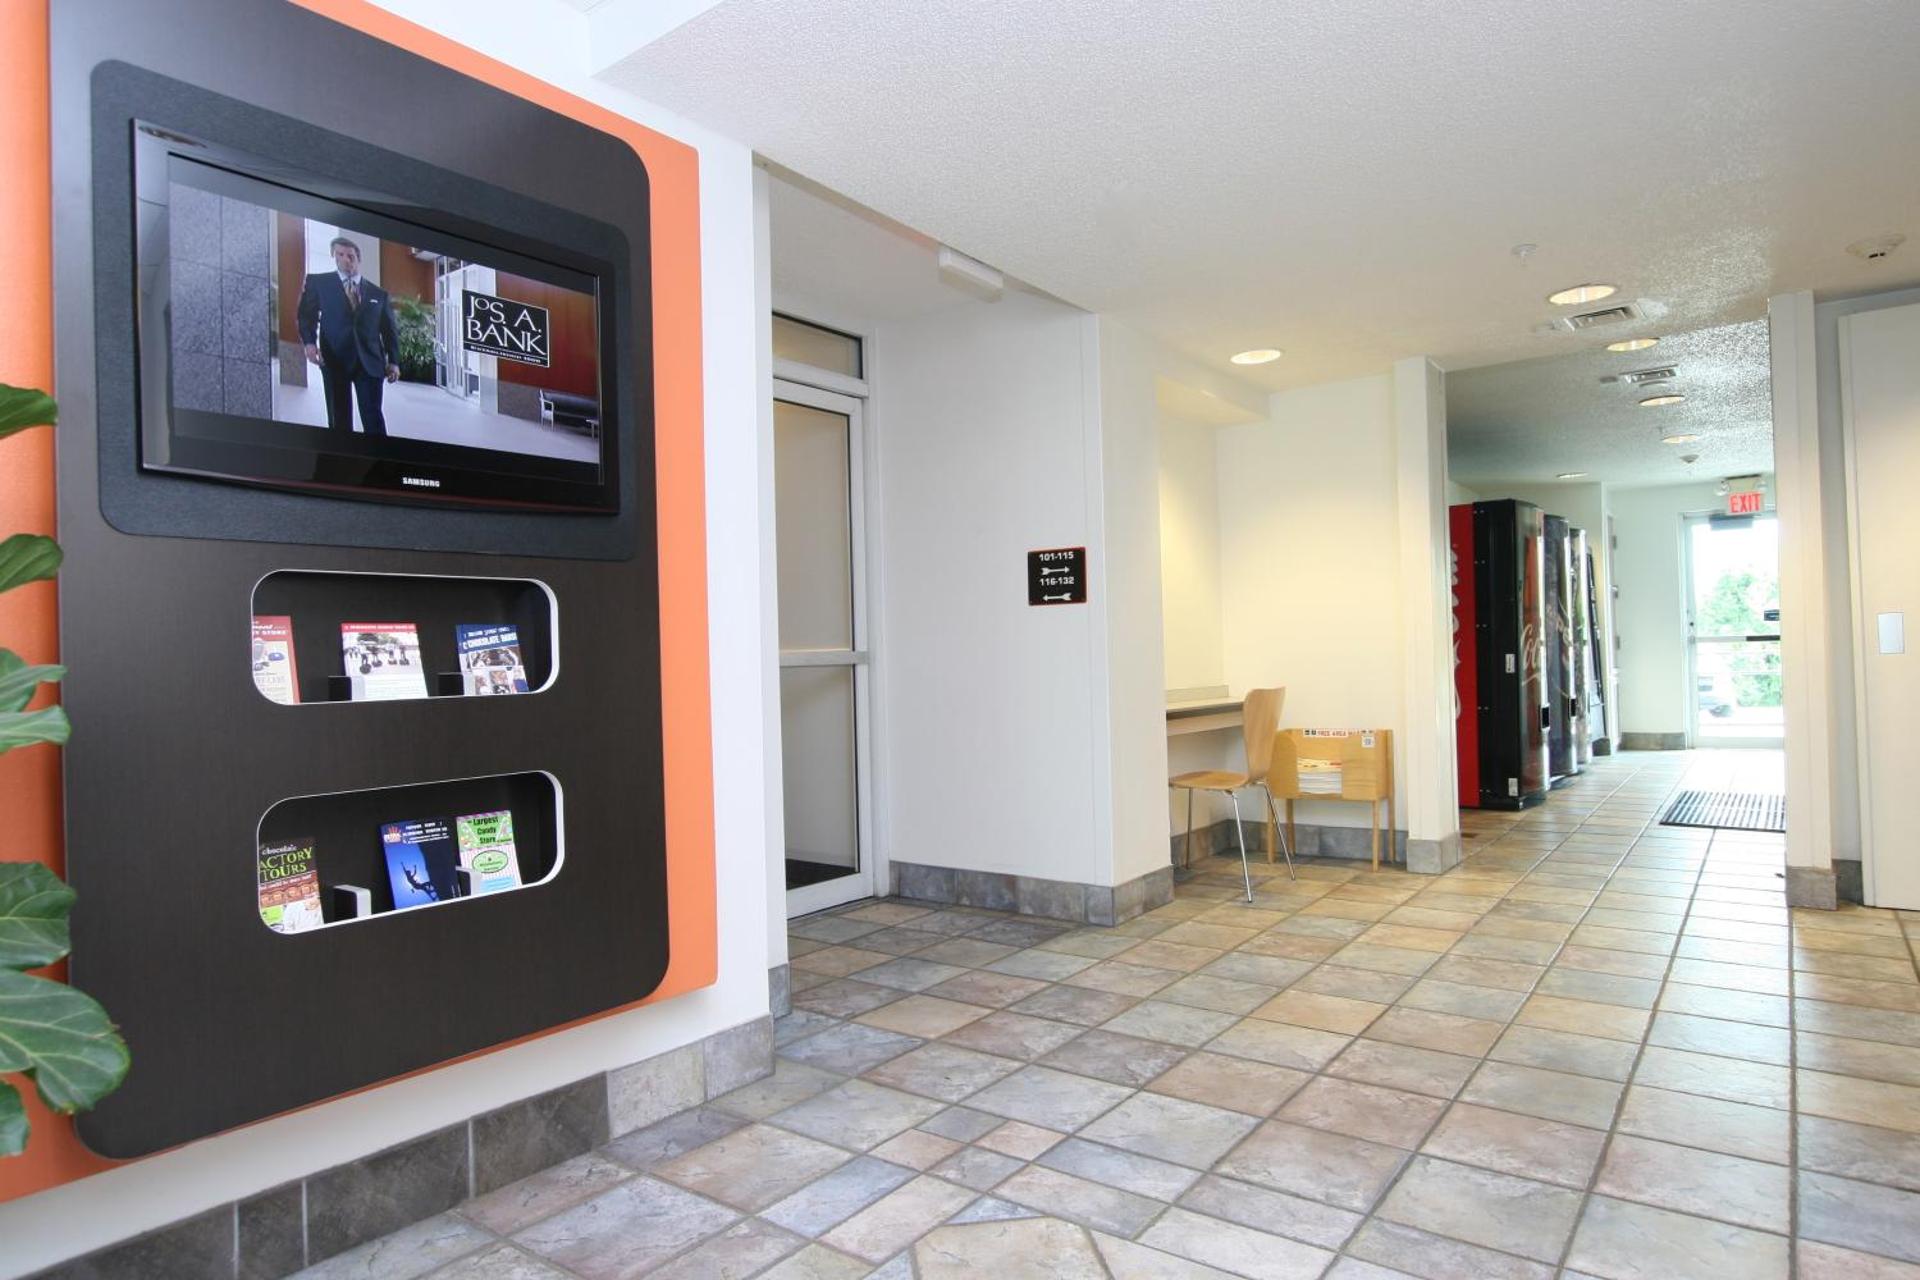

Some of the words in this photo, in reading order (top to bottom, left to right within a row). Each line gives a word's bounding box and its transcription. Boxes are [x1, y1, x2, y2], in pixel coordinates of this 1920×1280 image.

[514, 308, 542, 333] A.
[466, 318, 546, 356] BANK
[402, 476, 440, 488] SAMSUNG
[1731, 493, 1761, 513] EXIT
[1039, 551, 1074, 562] 101-115
[1039, 576, 1075, 587] 116-132
[260, 846, 312, 870] ACTORY
[261, 862, 307, 881] TOURS
